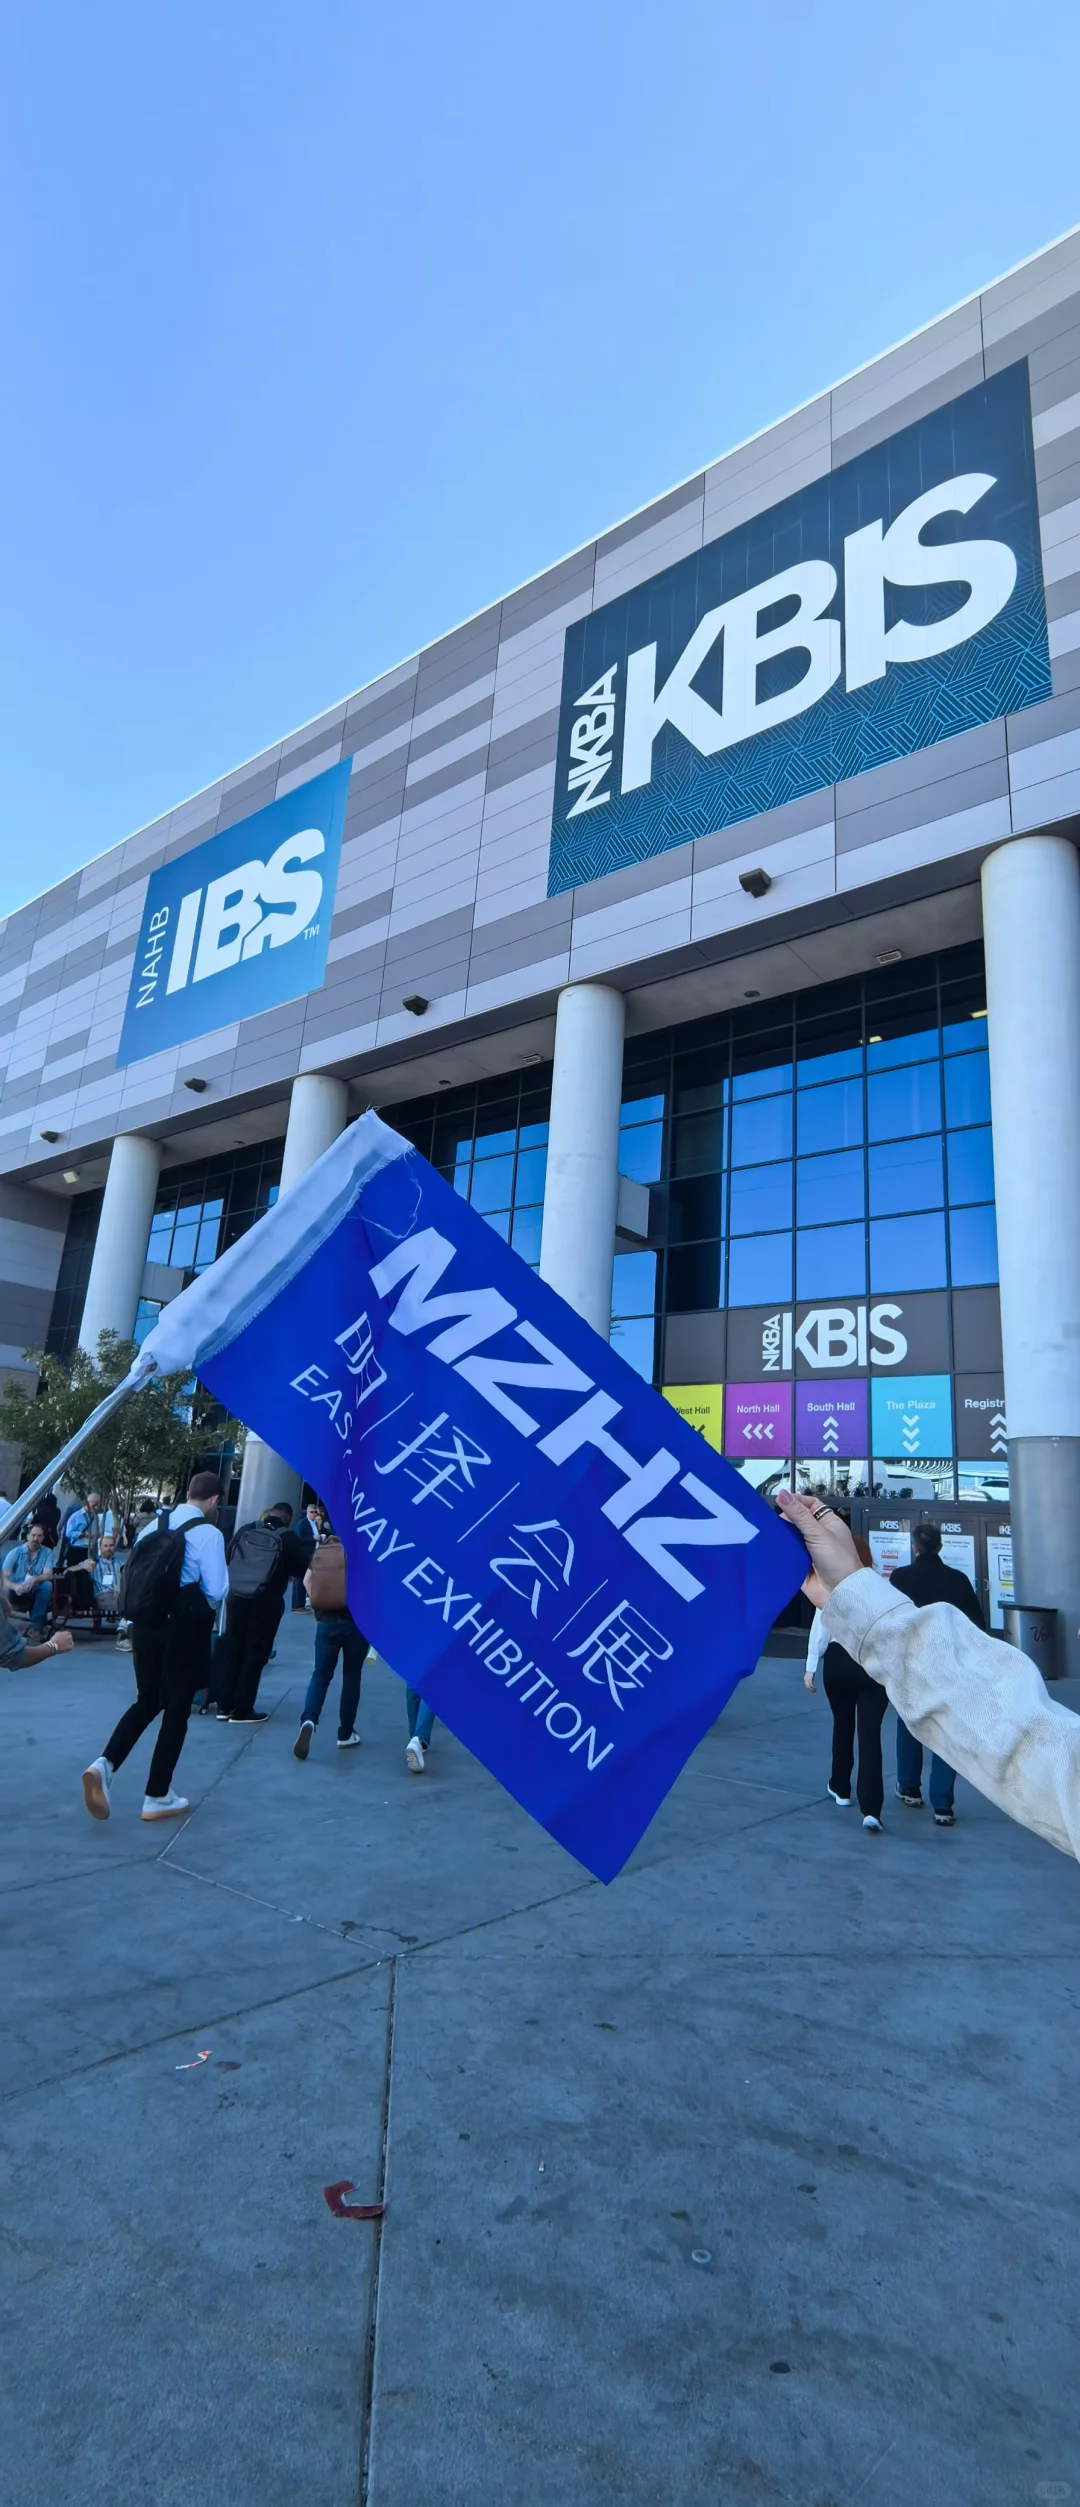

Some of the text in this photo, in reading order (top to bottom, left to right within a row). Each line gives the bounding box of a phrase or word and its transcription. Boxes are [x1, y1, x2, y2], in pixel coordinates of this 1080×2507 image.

[620, 472, 1018, 795] KBIS
[566, 662, 618, 819] NKBA
[165, 828, 325, 996] IBS
[135, 906, 169, 1009] NAHB
[762, 1314, 781, 1371] NKBA
[782, 1303, 908, 1370] KBIS
[368, 1226, 760, 1603] MZHZ
[694, 1406, 711, 1414] Hall
[737, 1404, 780, 1414] North Hall
[807, 1402, 855, 1412] South Hall
[886, 1400, 936, 1410] The Plaza
[401, 1558, 615, 1771] EXHIBITION
